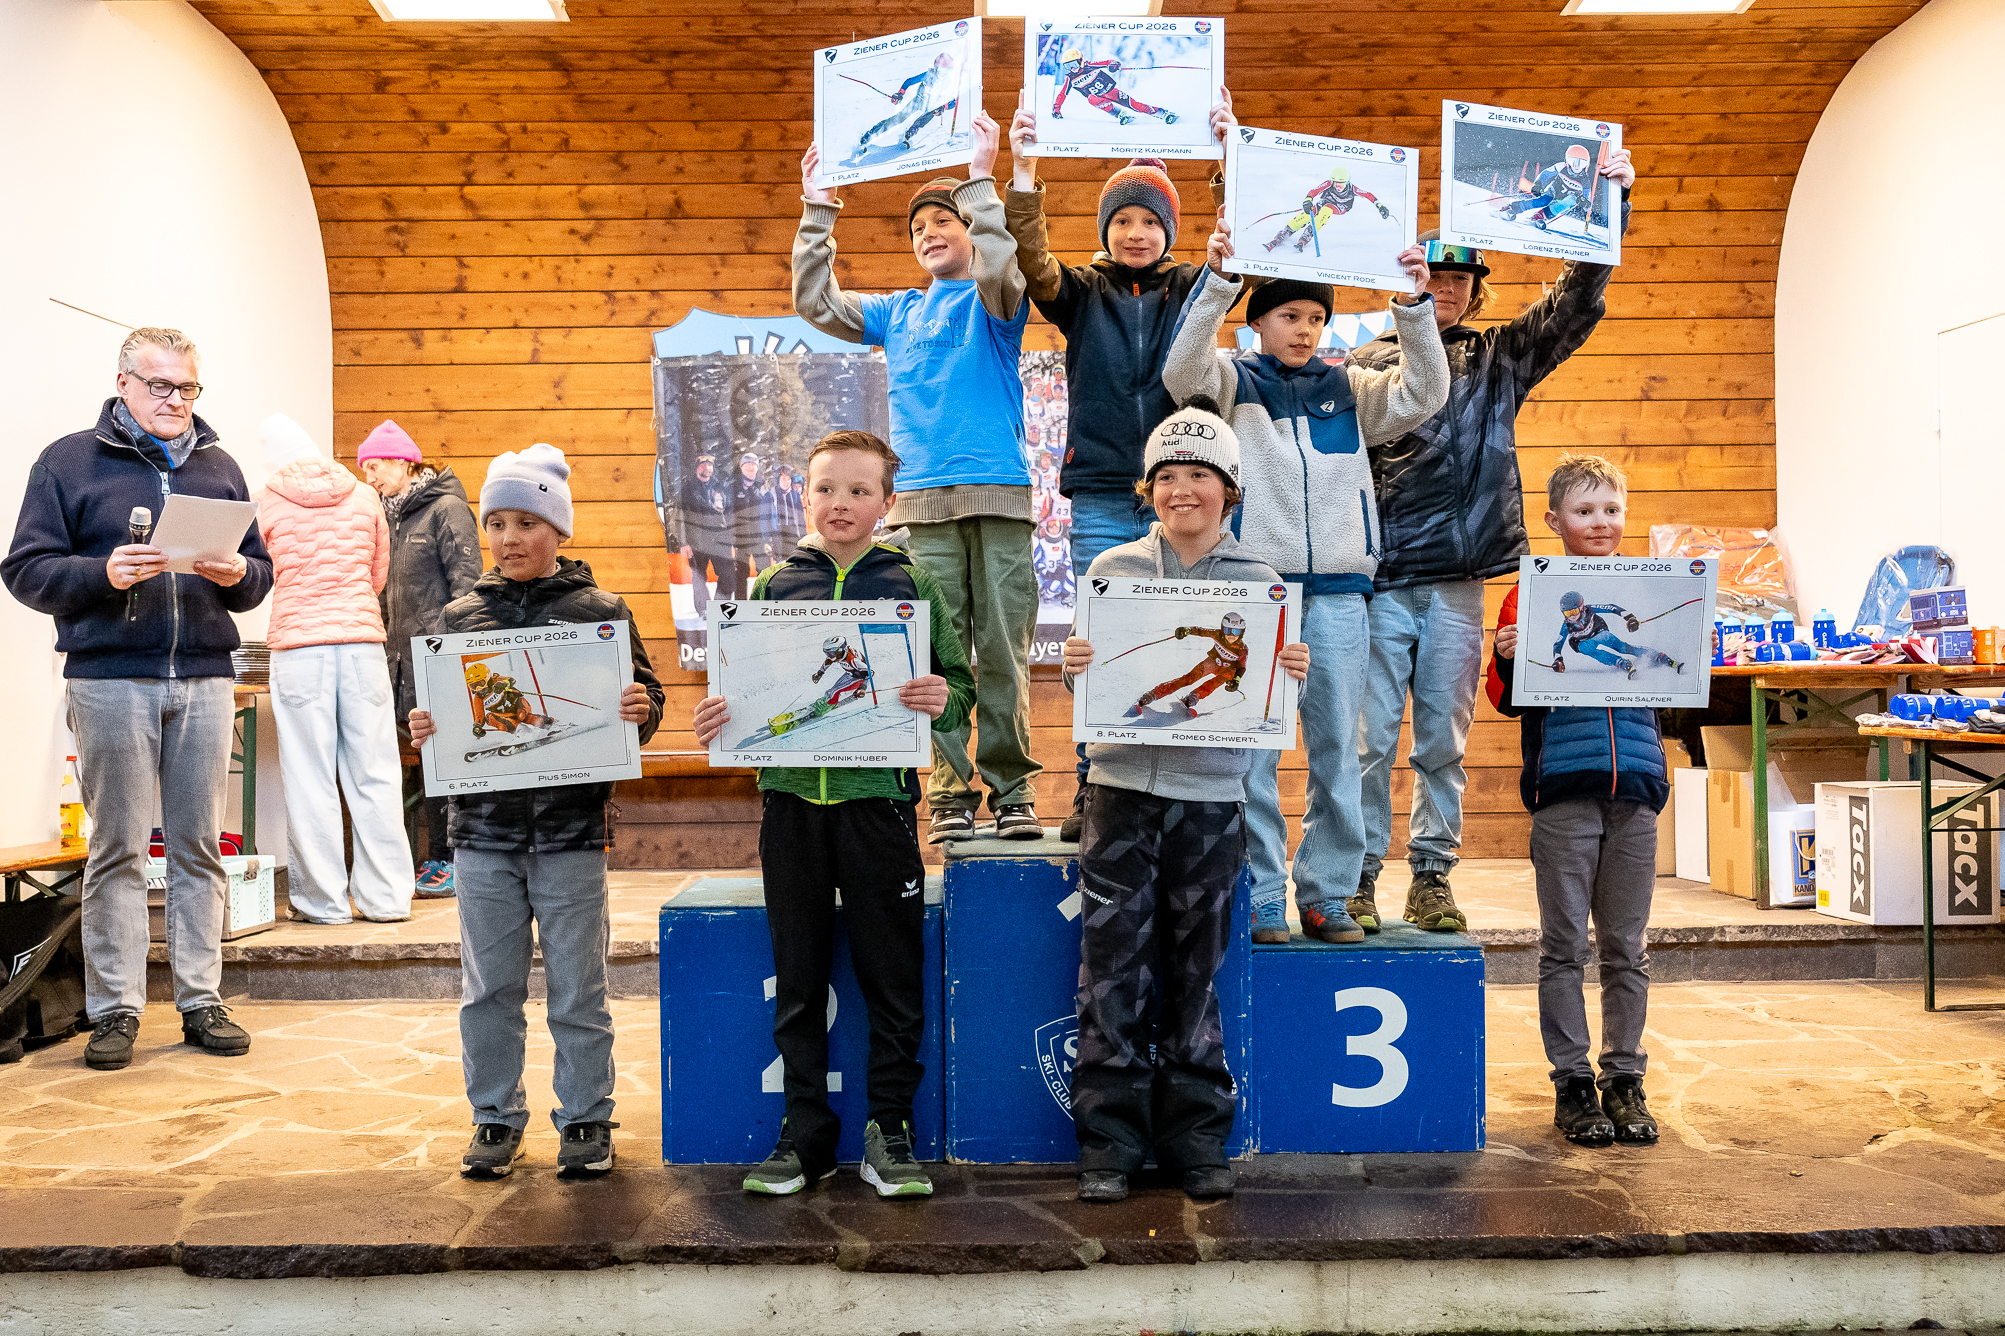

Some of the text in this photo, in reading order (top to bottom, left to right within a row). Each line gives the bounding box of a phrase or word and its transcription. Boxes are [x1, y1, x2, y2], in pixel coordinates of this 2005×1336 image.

[1146, 22, 1177, 30] 2026
[853, 31, 940, 55] ZIENER CUP 2026
[1488, 112, 1580, 132] ZIENER CUP 2026
[1274, 136, 1373, 156] ZIENER CUP 2026
[896, 161, 920, 171] JONAS
[838, 172, 860, 180] PLATZ
[1469, 237, 1494, 245] PLATZ
[1523, 244, 1590, 257] LORENZ STAUNER
[1253, 264, 1279, 273] PLATZ
[1316, 271, 1376, 284] VINCENT RODE
[1160, 439, 1182, 448] Aud
[1056, 508, 1068, 517] 43
[1569, 562, 1672, 572] ZIENER CUP 2026
[1132, 584, 1248, 597] ZIENER CUP 2026
[761, 607, 876, 616] ZIENER CUP 2026
[465, 631, 578, 648] ZIENER CUP 2026
[680, 643, 708, 662] De
[1171, 733, 1259, 743] ROMEO SCHWERTL
[460, 781, 489, 789] PLATZ
[1851, 804, 1867, 908] Tacx
[1953, 803, 1984, 908] Tacx
[1794, 884, 1816, 894] KAND
[1332, 986, 1410, 1108] 3
